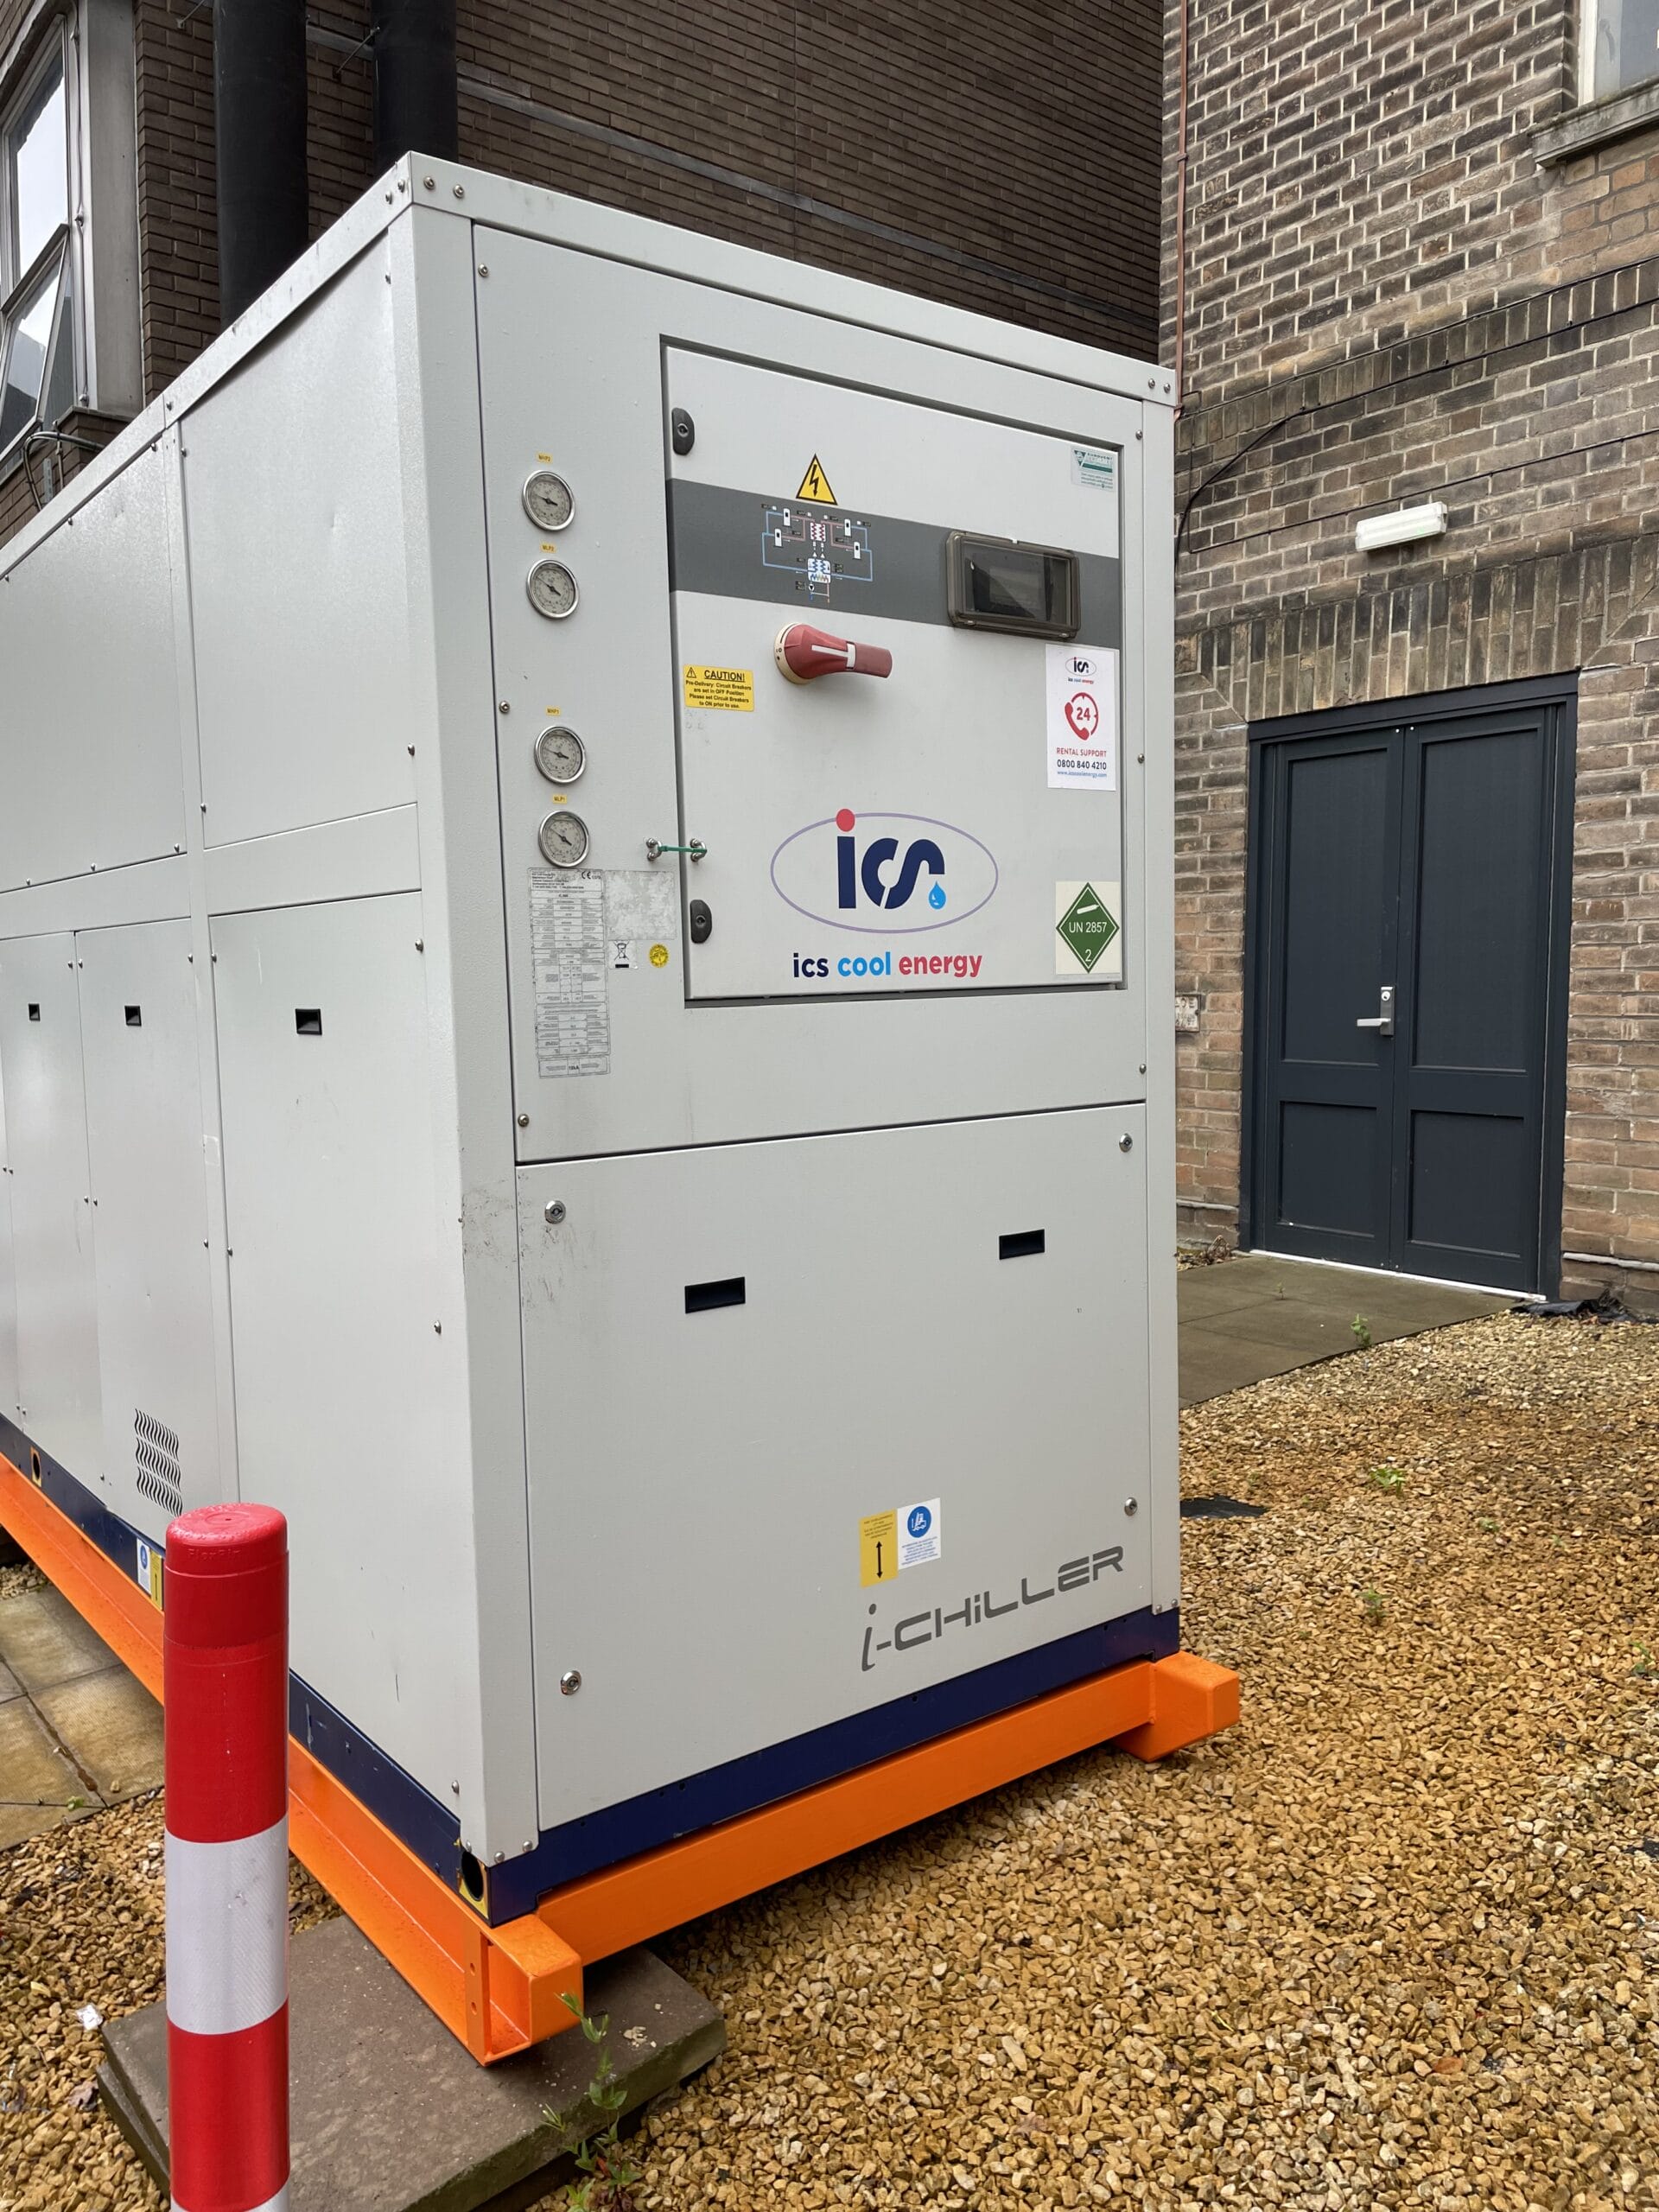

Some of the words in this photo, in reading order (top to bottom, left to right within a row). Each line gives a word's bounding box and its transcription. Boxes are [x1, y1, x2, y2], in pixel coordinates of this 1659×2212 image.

[704, 670, 745, 681] CAUTION!
[1077, 707, 1090, 721] 24
[1056, 747, 1078, 756] RENTAL
[1080, 749, 1107, 758] SUPPORT
[1057, 759, 1075, 768] 0800
[1077, 760, 1090, 769] 840
[1091, 761, 1107, 770] 4210
[836, 808, 946, 910] ics
[1069, 921, 1084, 933] UN
[1085, 921, 1107, 933] 2857
[1084, 949, 1091, 962] 2
[793, 952, 830, 978] ics
[837, 951, 891, 977] cool
[899, 954, 982, 978] energy
